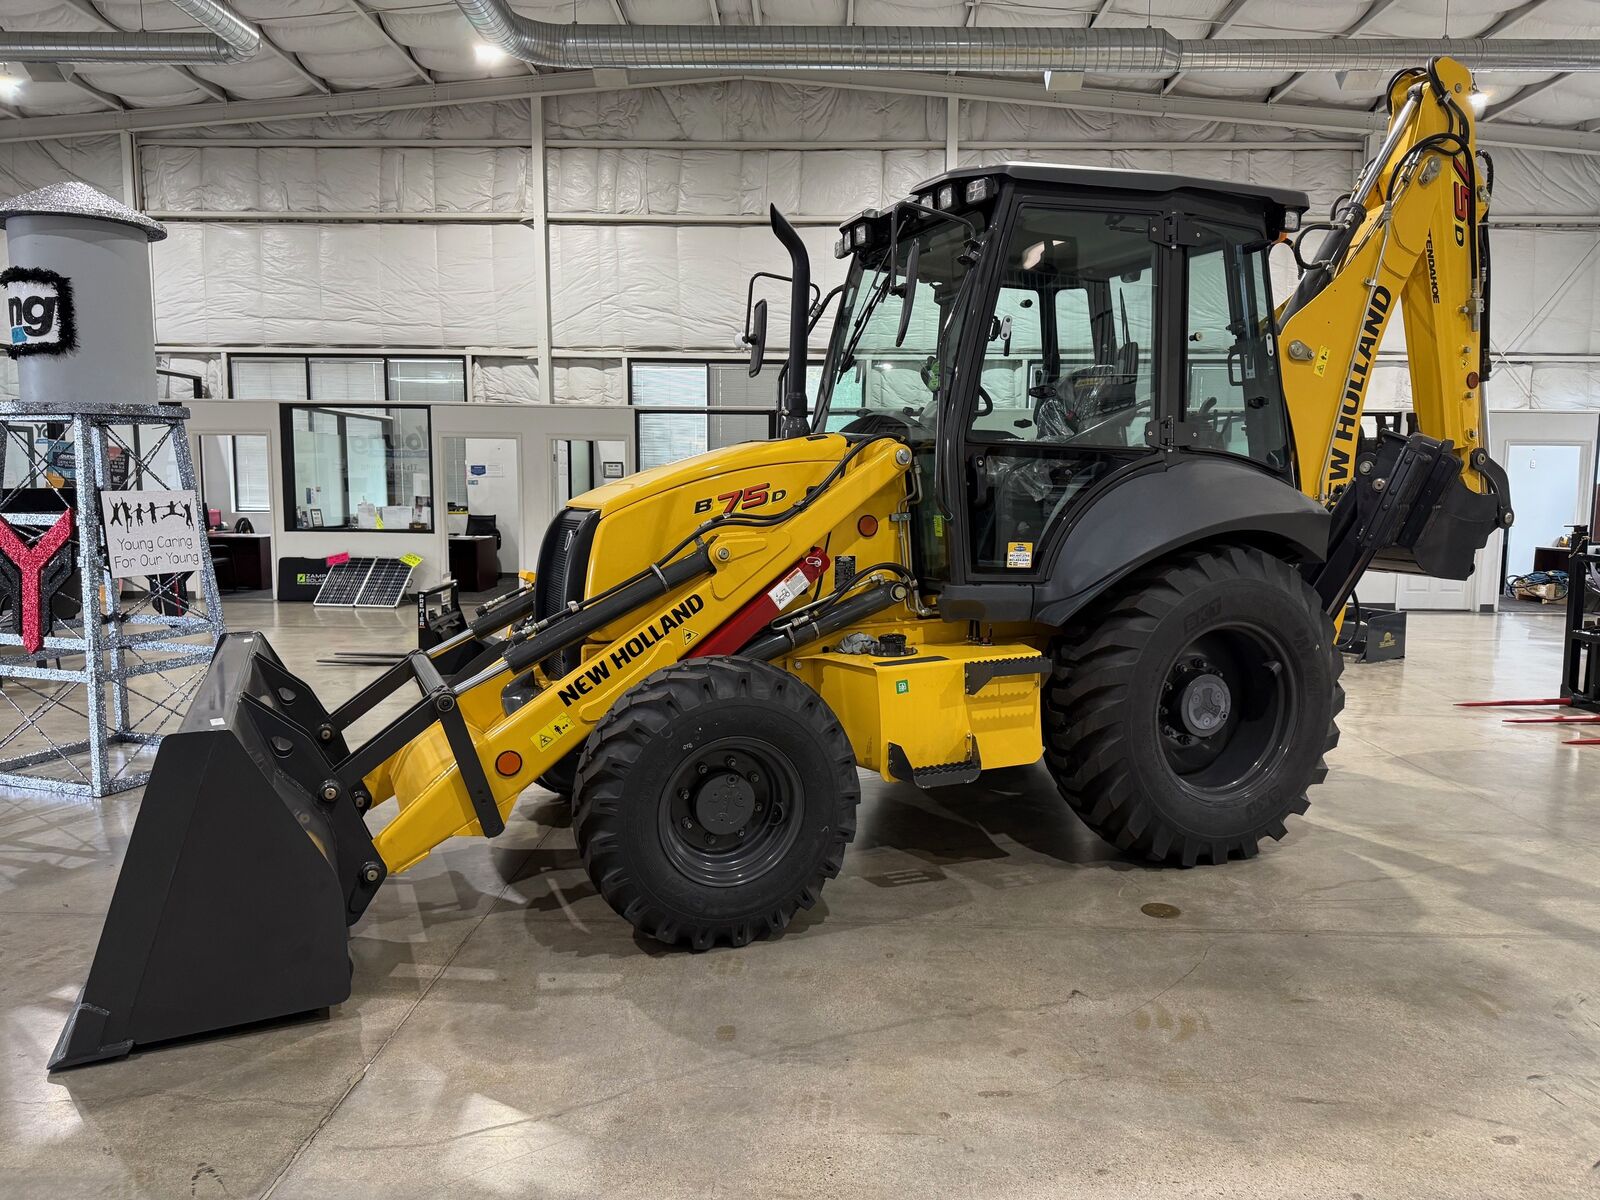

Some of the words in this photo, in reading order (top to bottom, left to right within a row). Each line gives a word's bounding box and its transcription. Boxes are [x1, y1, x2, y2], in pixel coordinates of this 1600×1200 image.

[1336, 285, 1391, 442] HOLLAND
[114, 555, 136, 569] For
[140, 554, 162, 567] Our
[166, 552, 199, 565] Young
[117, 538, 154, 552] Young
[157, 536, 192, 549] Caring
[557, 659, 611, 708] NEW
[609, 593, 705, 670] HOLLAND
